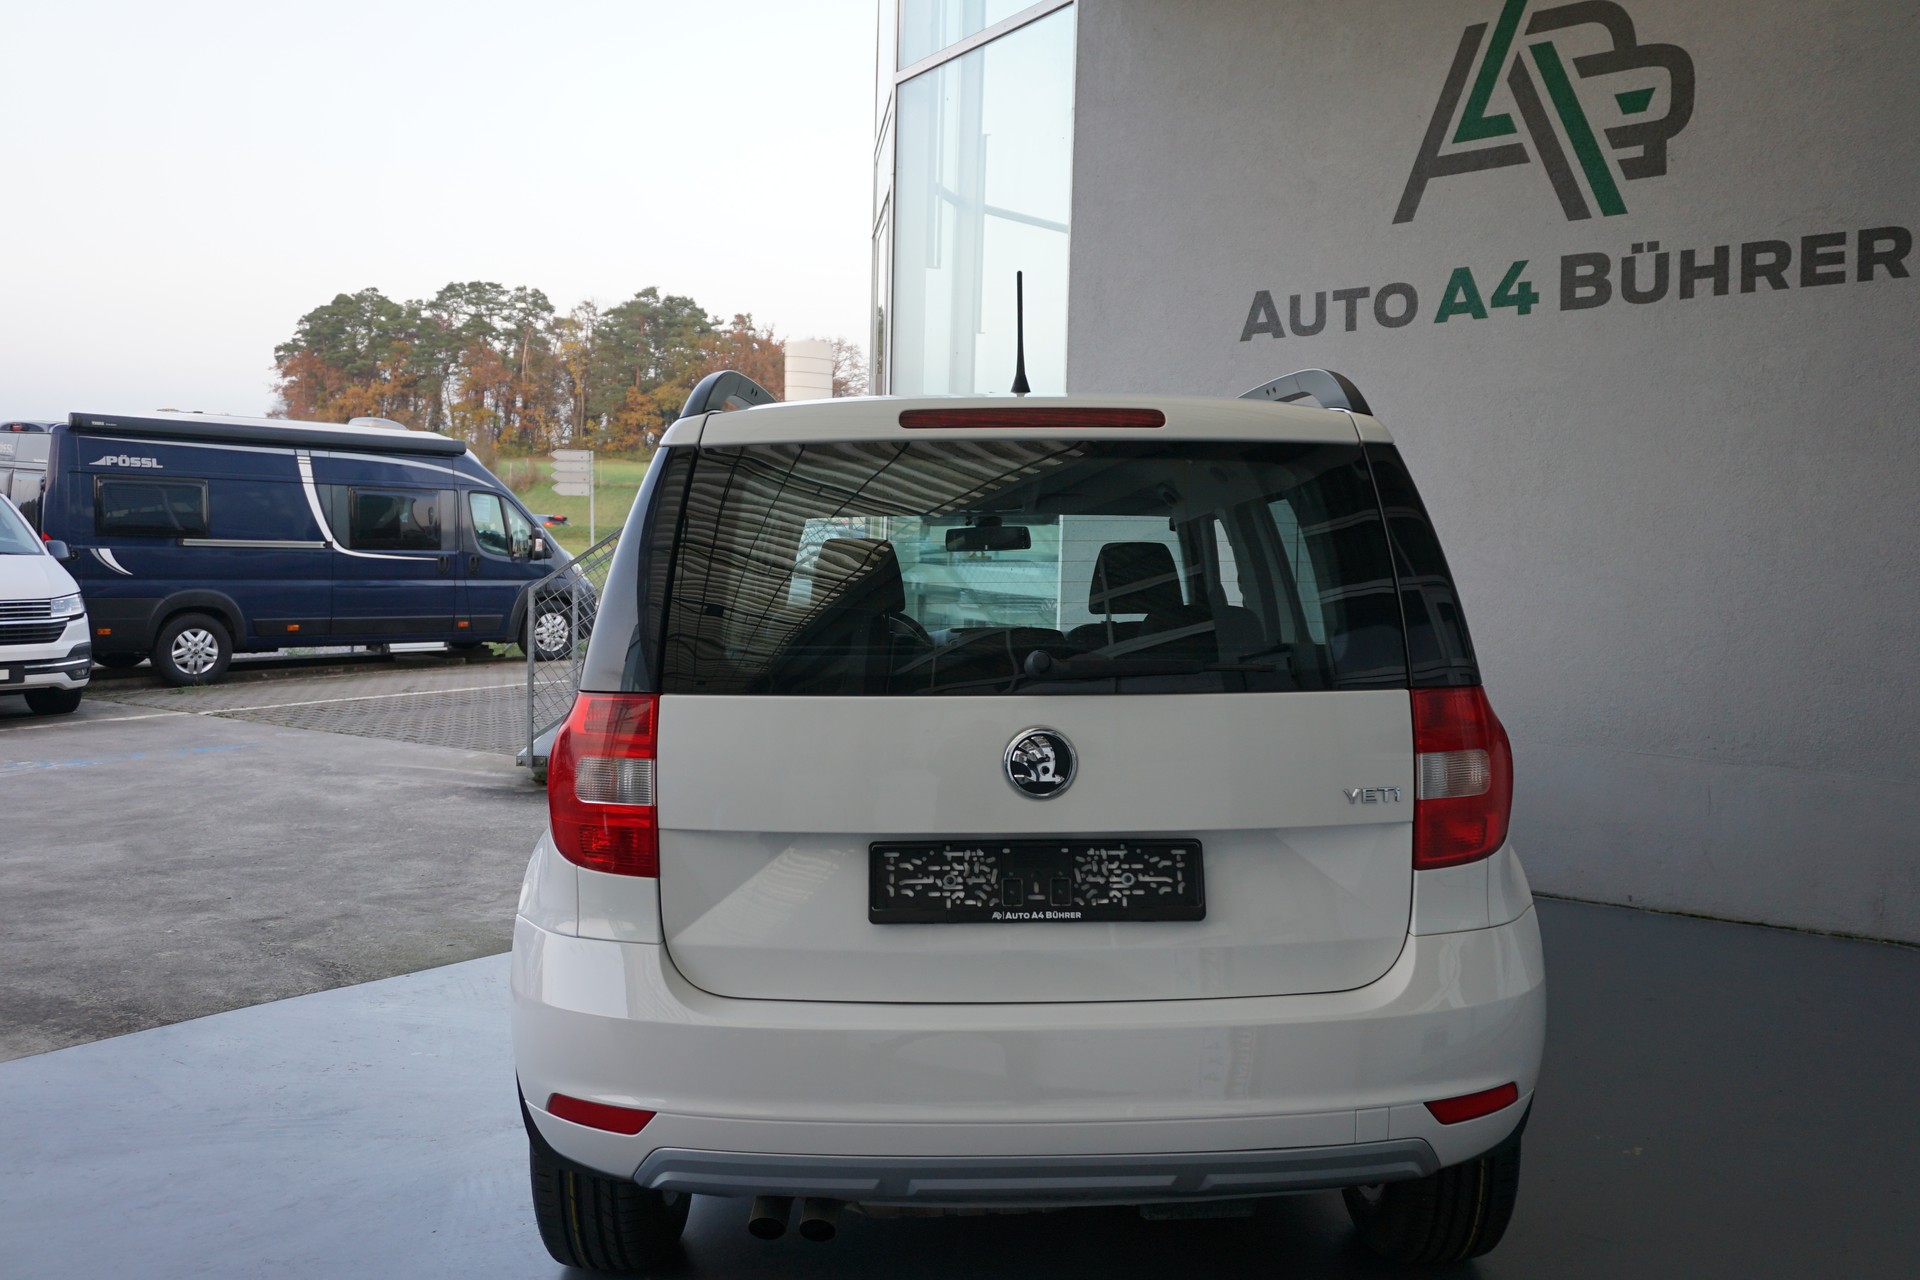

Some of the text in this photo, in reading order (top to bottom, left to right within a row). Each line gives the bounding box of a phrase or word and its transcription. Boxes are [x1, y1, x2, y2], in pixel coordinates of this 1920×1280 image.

[1239, 225, 1912, 342] AUTO A4 BÜHRER
[106, 455, 163, 468] PÖSSL
[1343, 787, 1401, 804] YETI
[1005, 911, 1030, 920] AUTO
[1031, 911, 1044, 919] A4
[1045, 910, 1082, 919] BÜHRER
